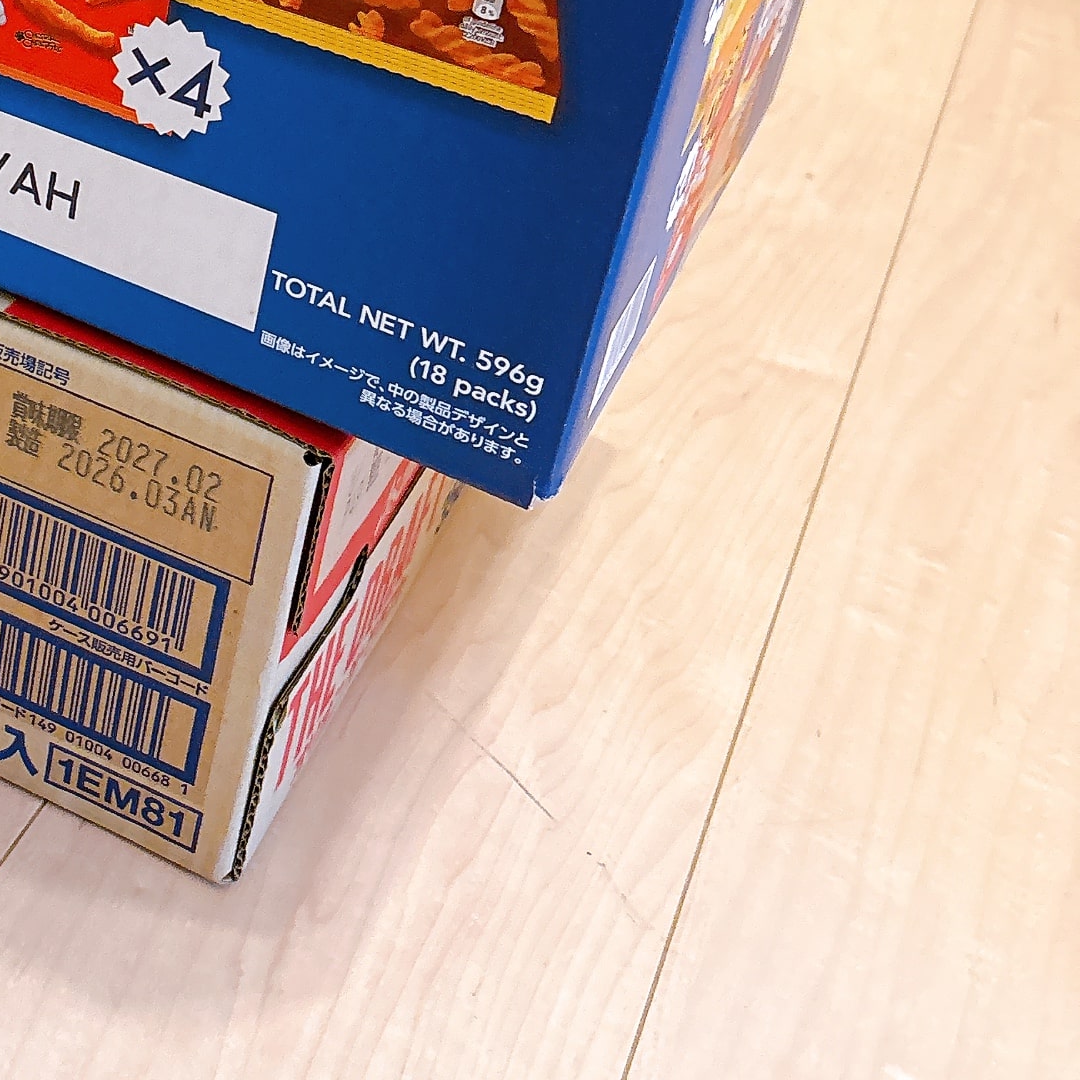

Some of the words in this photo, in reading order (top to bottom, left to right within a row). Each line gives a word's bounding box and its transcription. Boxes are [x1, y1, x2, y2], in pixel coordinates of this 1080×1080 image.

[271, 269, 351, 319] TOTAL
[358, 304, 415, 340] NET
[420, 327, 466, 363] WT.
[475, 349, 546, 396] 596g
[260, 329, 531, 450] 画像はイメージで、中の製品デザインと
[358, 388, 523, 465] 異なる場合があります。
[409, 355, 448, 386] (18
[452, 378, 538, 424] packs)
[96, 428, 222, 504] 2027.02
[48, 618, 211, 696] ケース販売用バーコード
[57, 758, 186, 839] 1EM81
[65, 731, 113, 761] 01004
[122, 756, 170, 788] 00668
[180, 783, 189, 796] 1
